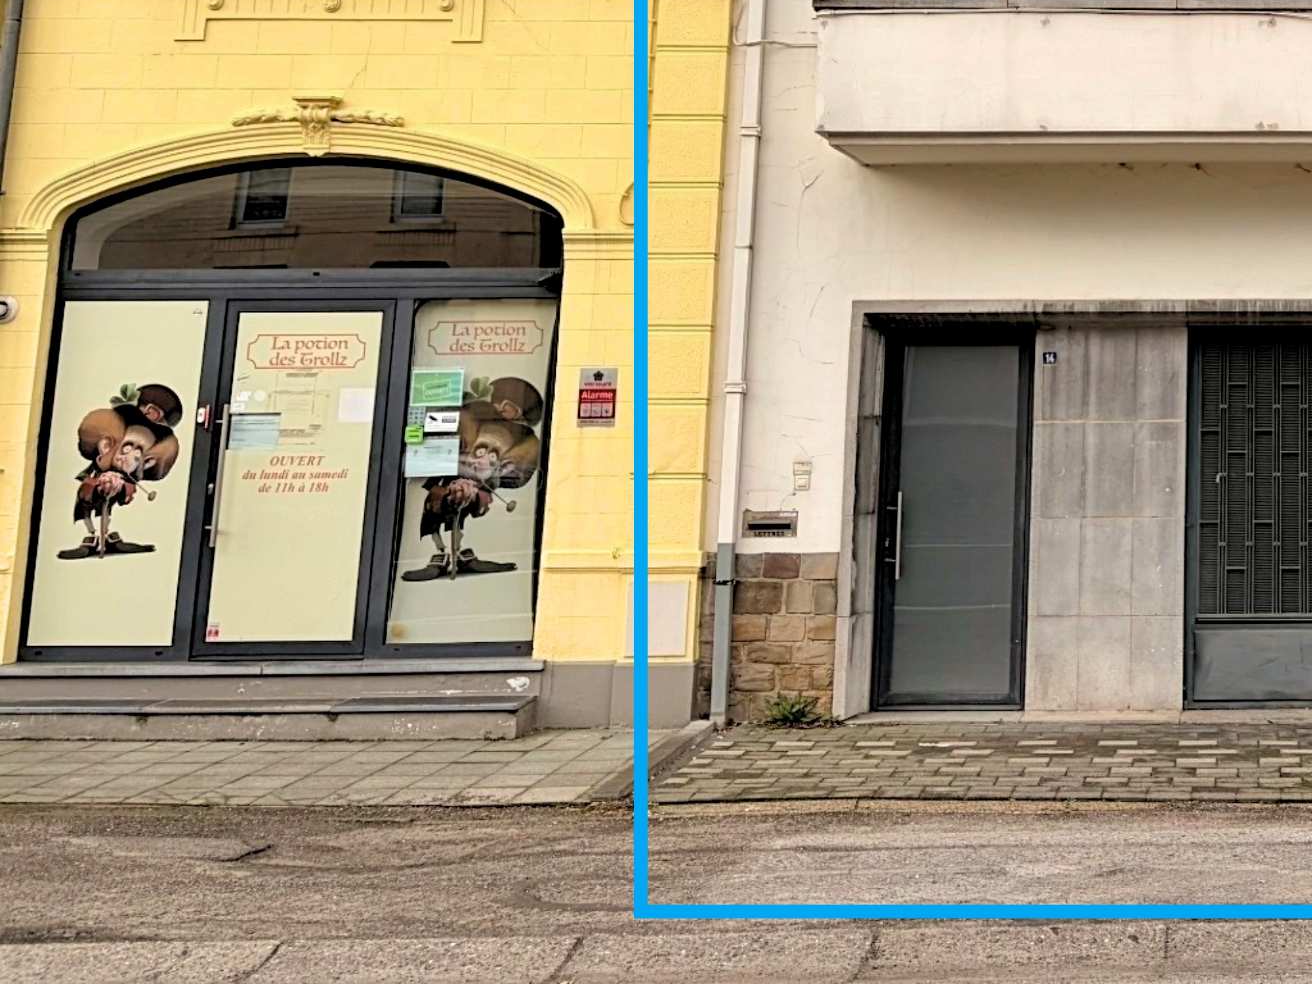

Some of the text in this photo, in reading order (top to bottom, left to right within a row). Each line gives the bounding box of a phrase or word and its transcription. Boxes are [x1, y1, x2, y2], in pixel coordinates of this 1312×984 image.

[452, 322, 526, 340] La potion
[271, 336, 348, 354] La potion
[449, 338, 475, 352] des
[269, 352, 296, 366] des
[1045, 353, 1055, 363] 14
[581, 390, 614, 400] Alarme
[269, 455, 326, 466] OUVERT
[241, 468, 349, 480] du lundi au samedi
[257, 482, 329, 493] de 11h à 18h
